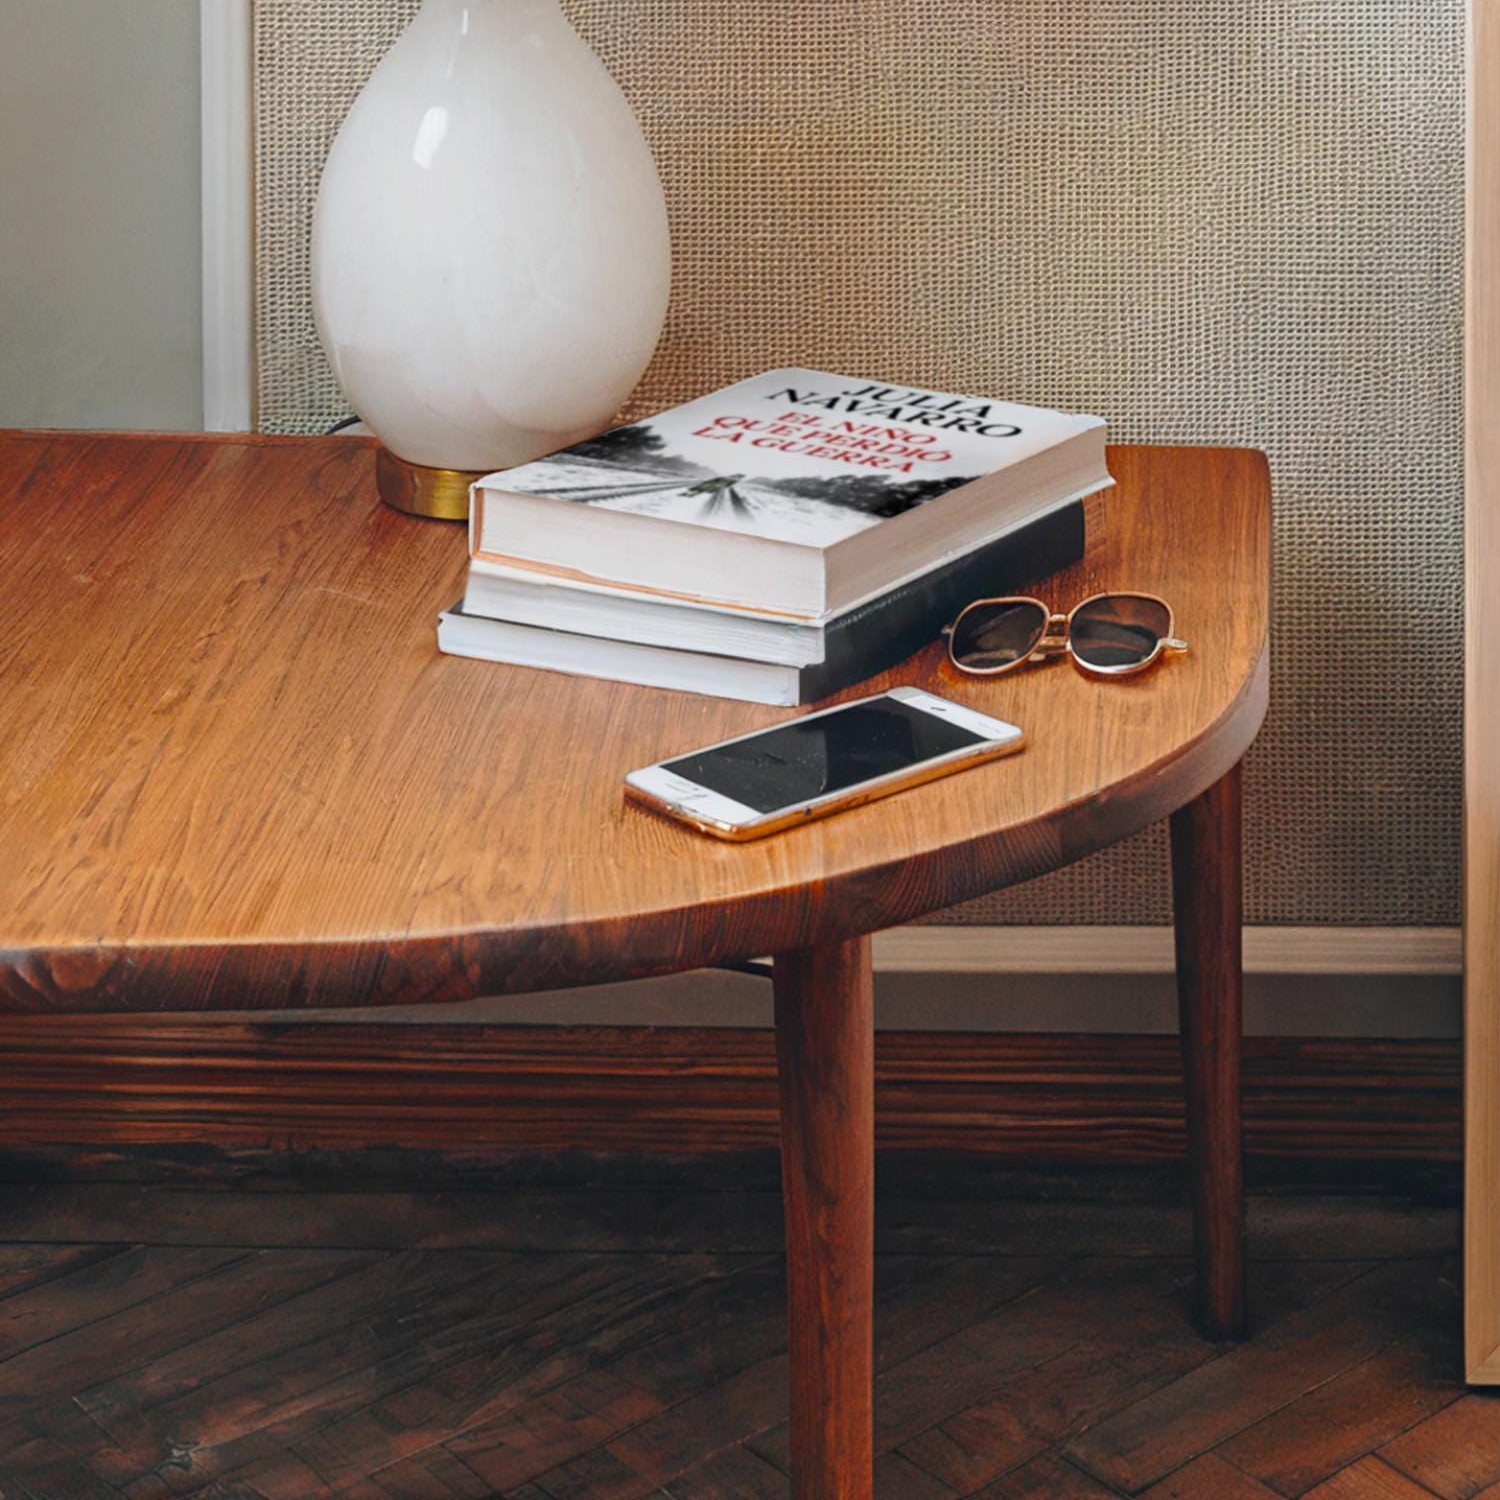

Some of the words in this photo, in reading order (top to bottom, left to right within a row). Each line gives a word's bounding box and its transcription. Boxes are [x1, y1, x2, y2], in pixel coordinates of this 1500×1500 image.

[766, 388, 1022, 438] NAVARRO
[843, 385, 992, 419] JULIA
[691, 426, 747, 444] LA
[750, 438, 914, 474] GUERRA
[713, 415, 796, 438] QUE
[801, 430, 954, 463] PERDIÓ
[775, 411, 824, 426] EL
[830, 419, 938, 445] NIÑO
